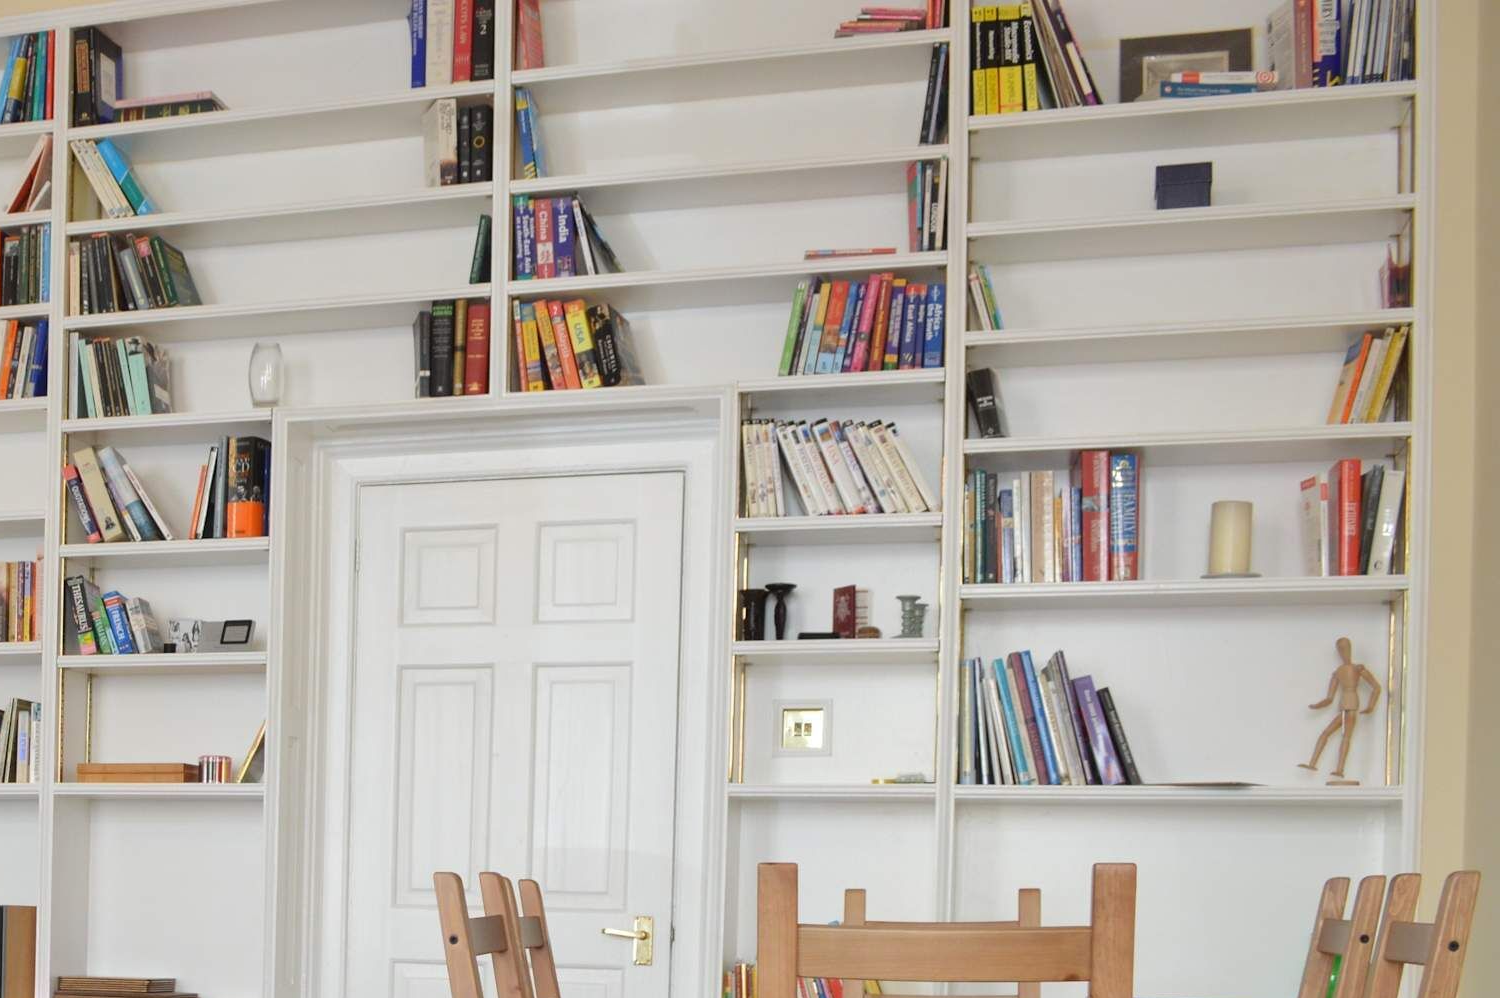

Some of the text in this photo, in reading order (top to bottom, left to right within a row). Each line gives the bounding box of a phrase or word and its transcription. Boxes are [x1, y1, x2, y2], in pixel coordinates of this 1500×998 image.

[540, 211, 548, 240] China
[558, 214, 569, 242] India
[905, 321, 914, 342] Africa
[933, 304, 942, 330] Africa
[574, 323, 584, 345] USA
[606, 335, 617, 373] CROMWELL
[72, 486, 91, 523] QUOTATIONS
[1123, 494, 1136, 533] FAMILY
[71, 585, 89, 630] THESAURUS
[112, 611, 125, 640] FRENCH
